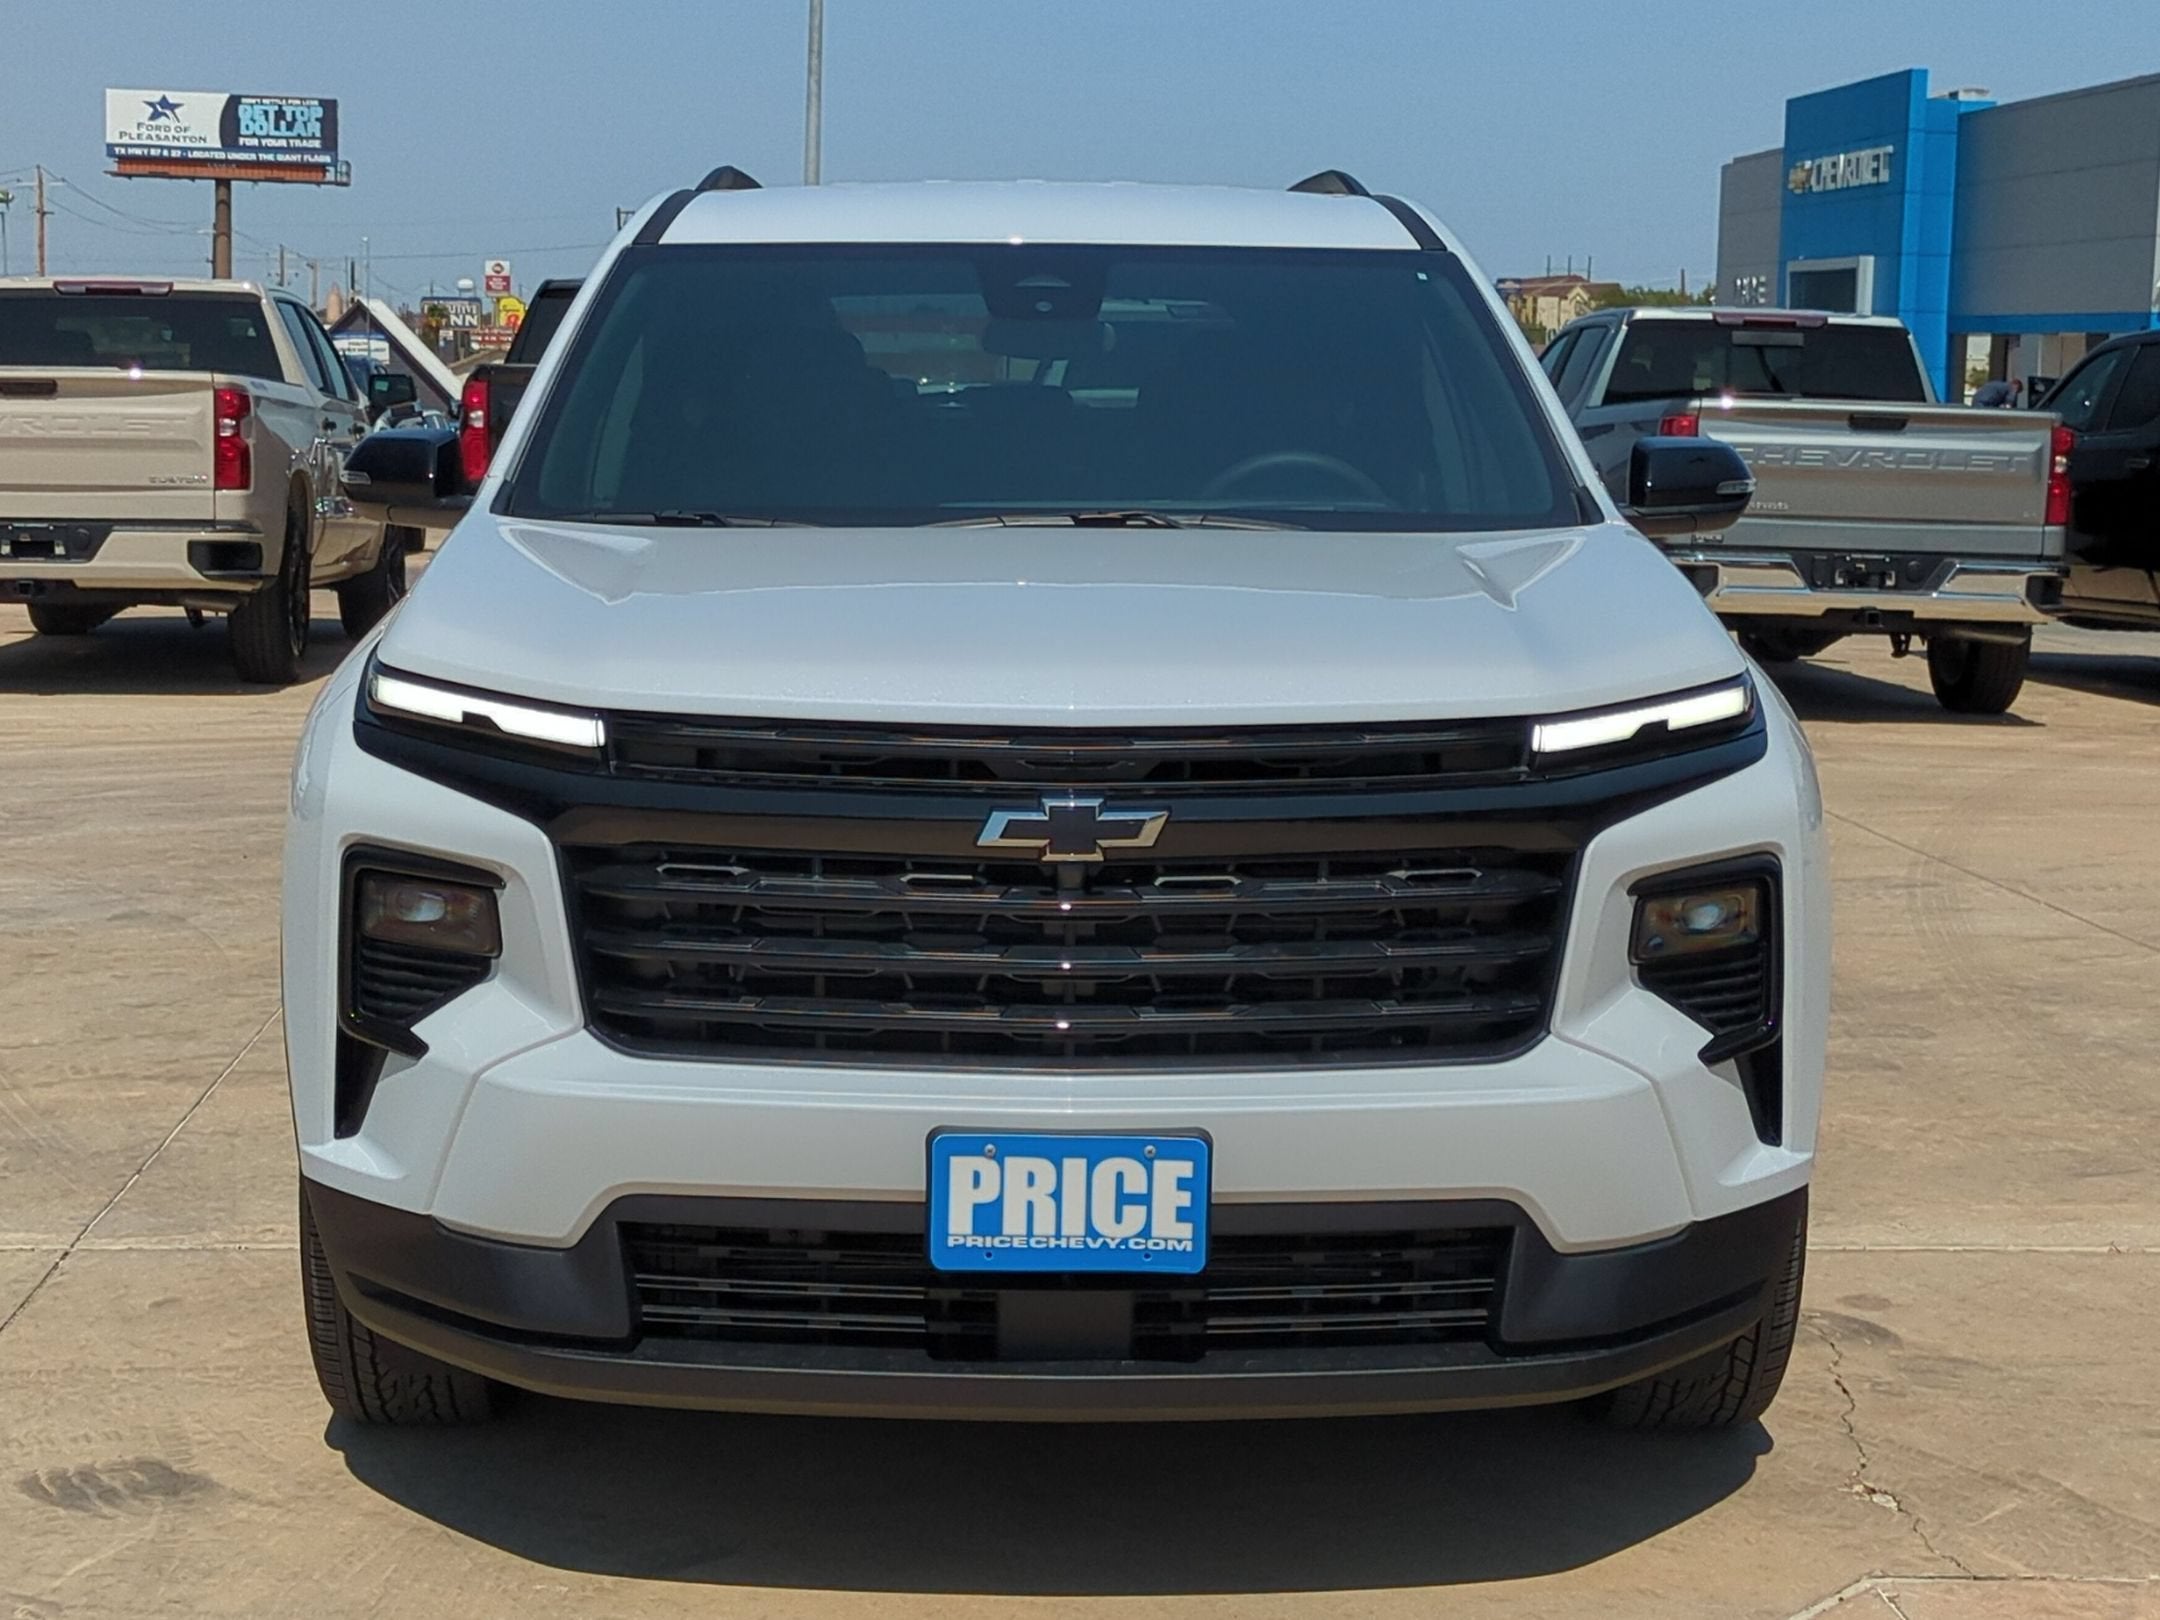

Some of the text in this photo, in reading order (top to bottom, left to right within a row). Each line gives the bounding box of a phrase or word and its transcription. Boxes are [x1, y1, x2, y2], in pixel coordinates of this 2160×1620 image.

[281, 106, 323, 122] TOP
[240, 119, 321, 137] DOLLAR
[0, 415, 187, 435] ROLET
[948, 1155, 1194, 1240] PRICE
[947, 1235, 1193, 1252] PRICECHEVY.COM
